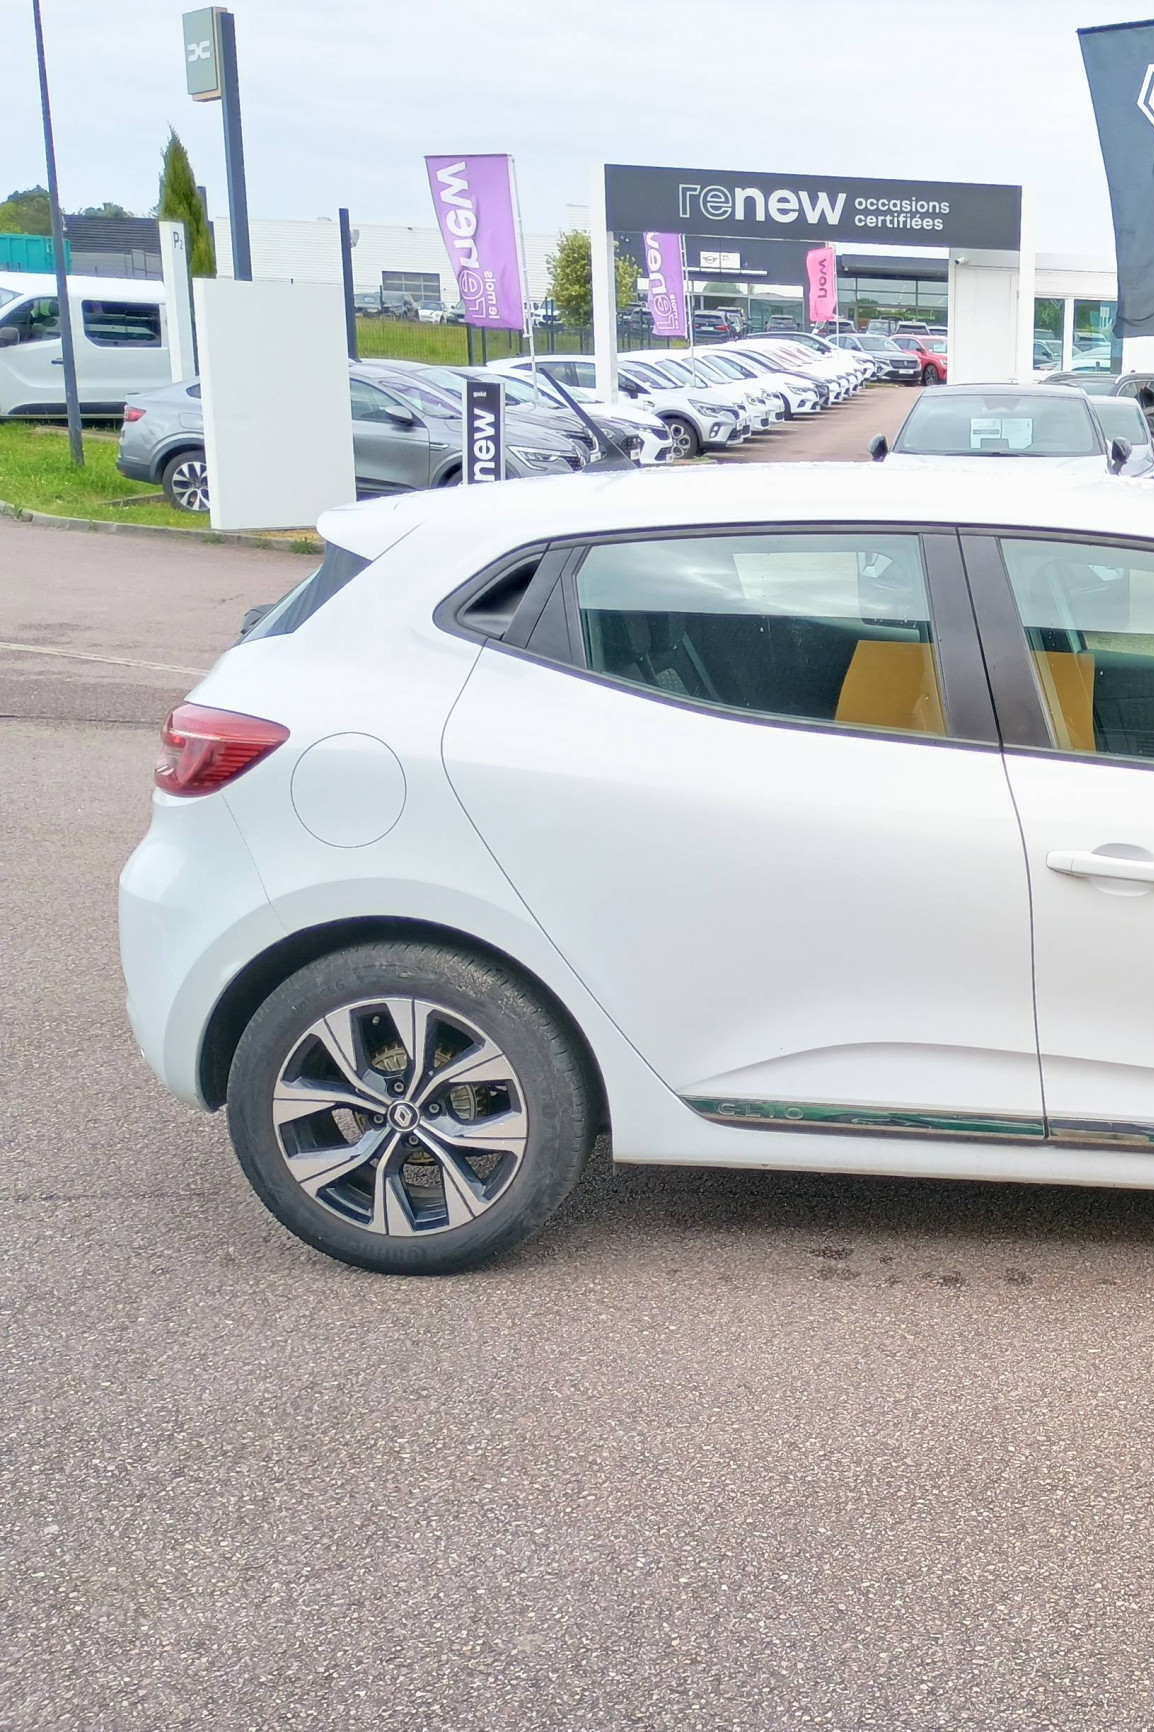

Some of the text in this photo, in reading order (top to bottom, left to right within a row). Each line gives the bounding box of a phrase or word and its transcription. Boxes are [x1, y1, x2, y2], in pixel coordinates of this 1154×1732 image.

[678, 183, 847, 225] renew
[854, 197, 950, 214] occasions
[854, 213, 944, 230] certifiées
[716, 1102, 806, 1120] CLIO
